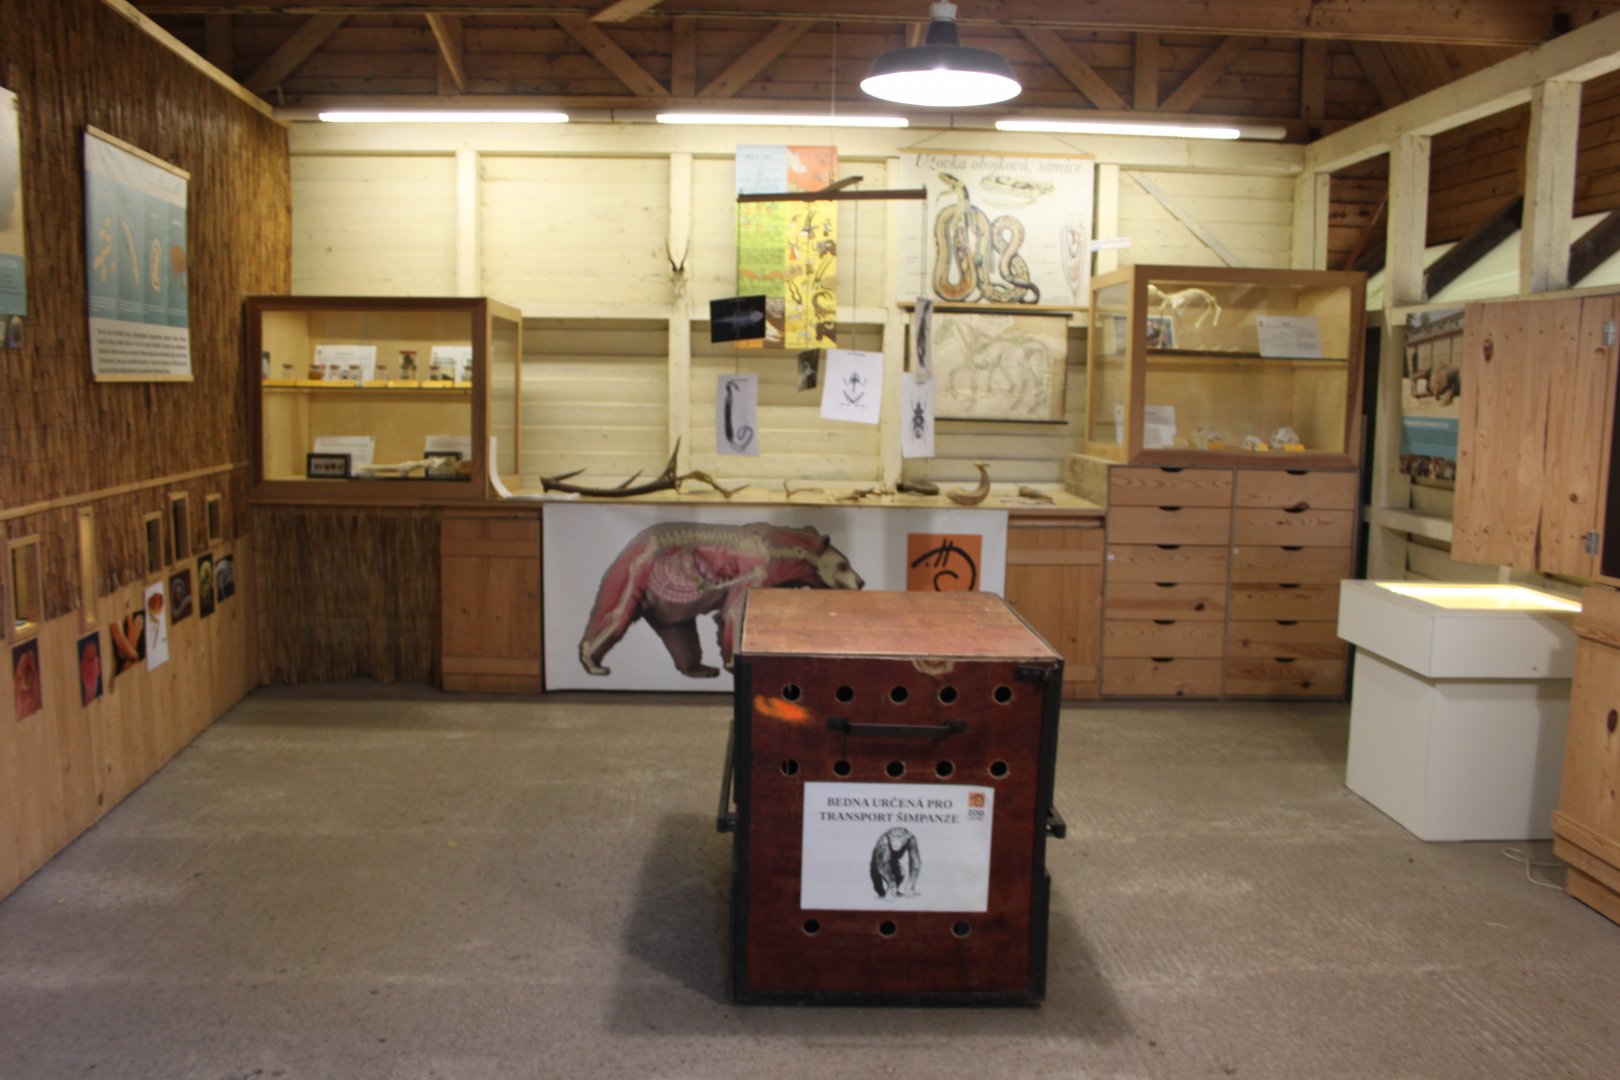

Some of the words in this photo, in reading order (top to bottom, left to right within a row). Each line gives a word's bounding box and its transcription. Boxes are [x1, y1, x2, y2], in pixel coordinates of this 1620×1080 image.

[827, 797, 869, 808] BEDNA
[872, 796, 924, 809] URČENÁ
[927, 800, 953, 809] PRO
[819, 811, 893, 822] TRANSPORT
[896, 811, 960, 824] ŠIMPANZE
